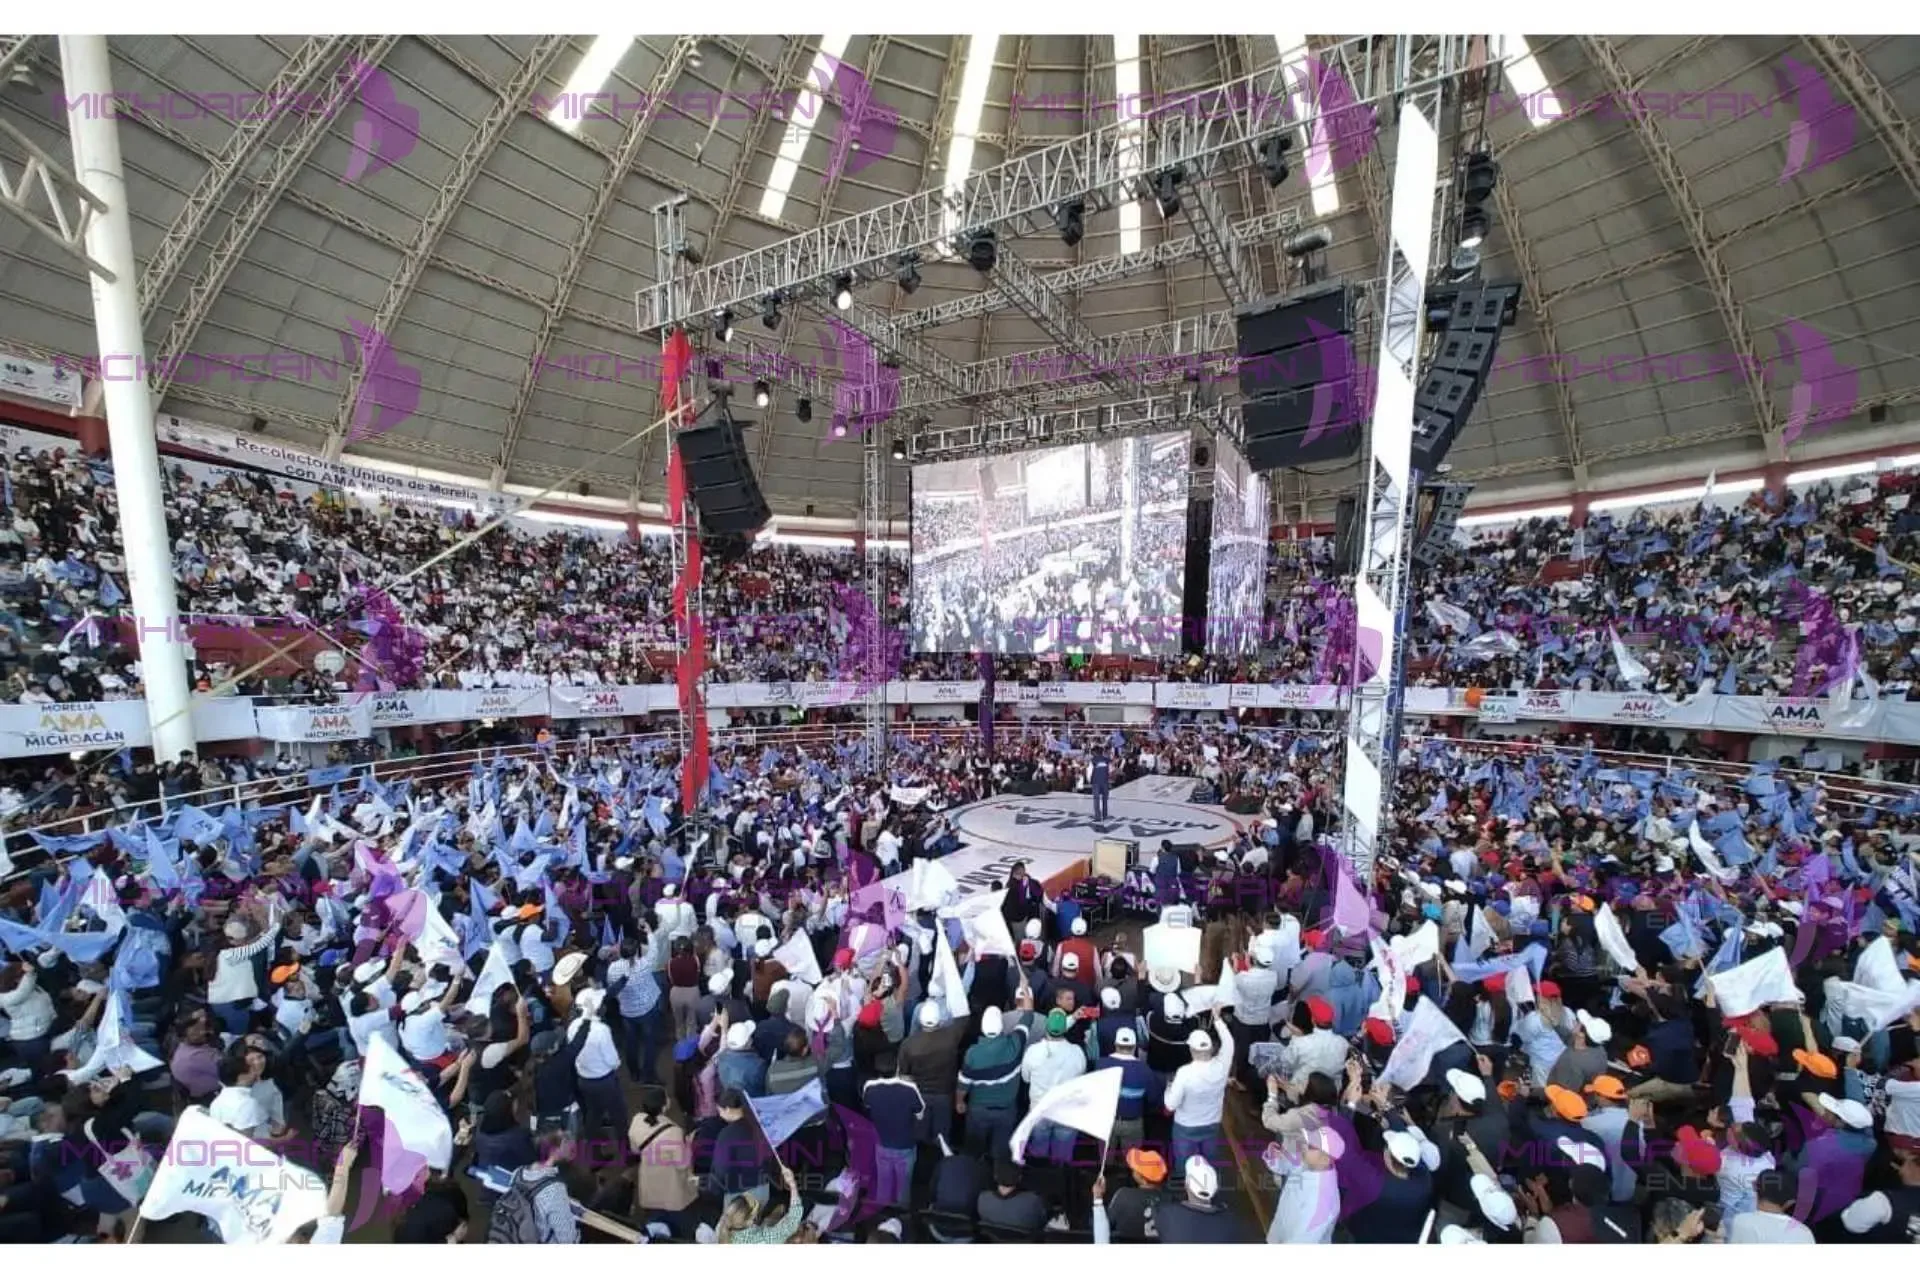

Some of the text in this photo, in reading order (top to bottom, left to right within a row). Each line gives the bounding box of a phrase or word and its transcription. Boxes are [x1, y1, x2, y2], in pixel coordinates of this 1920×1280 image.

[236, 437, 346, 474] Recolectores
[352, 467, 403, 487] Unidos
[408, 480, 425, 491] de
[429, 483, 478, 500] Morelia
[320, 472, 356, 488] AMA
[41, 703, 96, 713] MORELIA
[375, 700, 410, 712] AMA
[1526, 697, 1561, 709] AMA
[1771, 705, 1820, 720] AMA
[40, 713, 107, 730] AMA
[311, 715, 353, 729] AMA
[25, 730, 125, 748] MICHOACÁN
